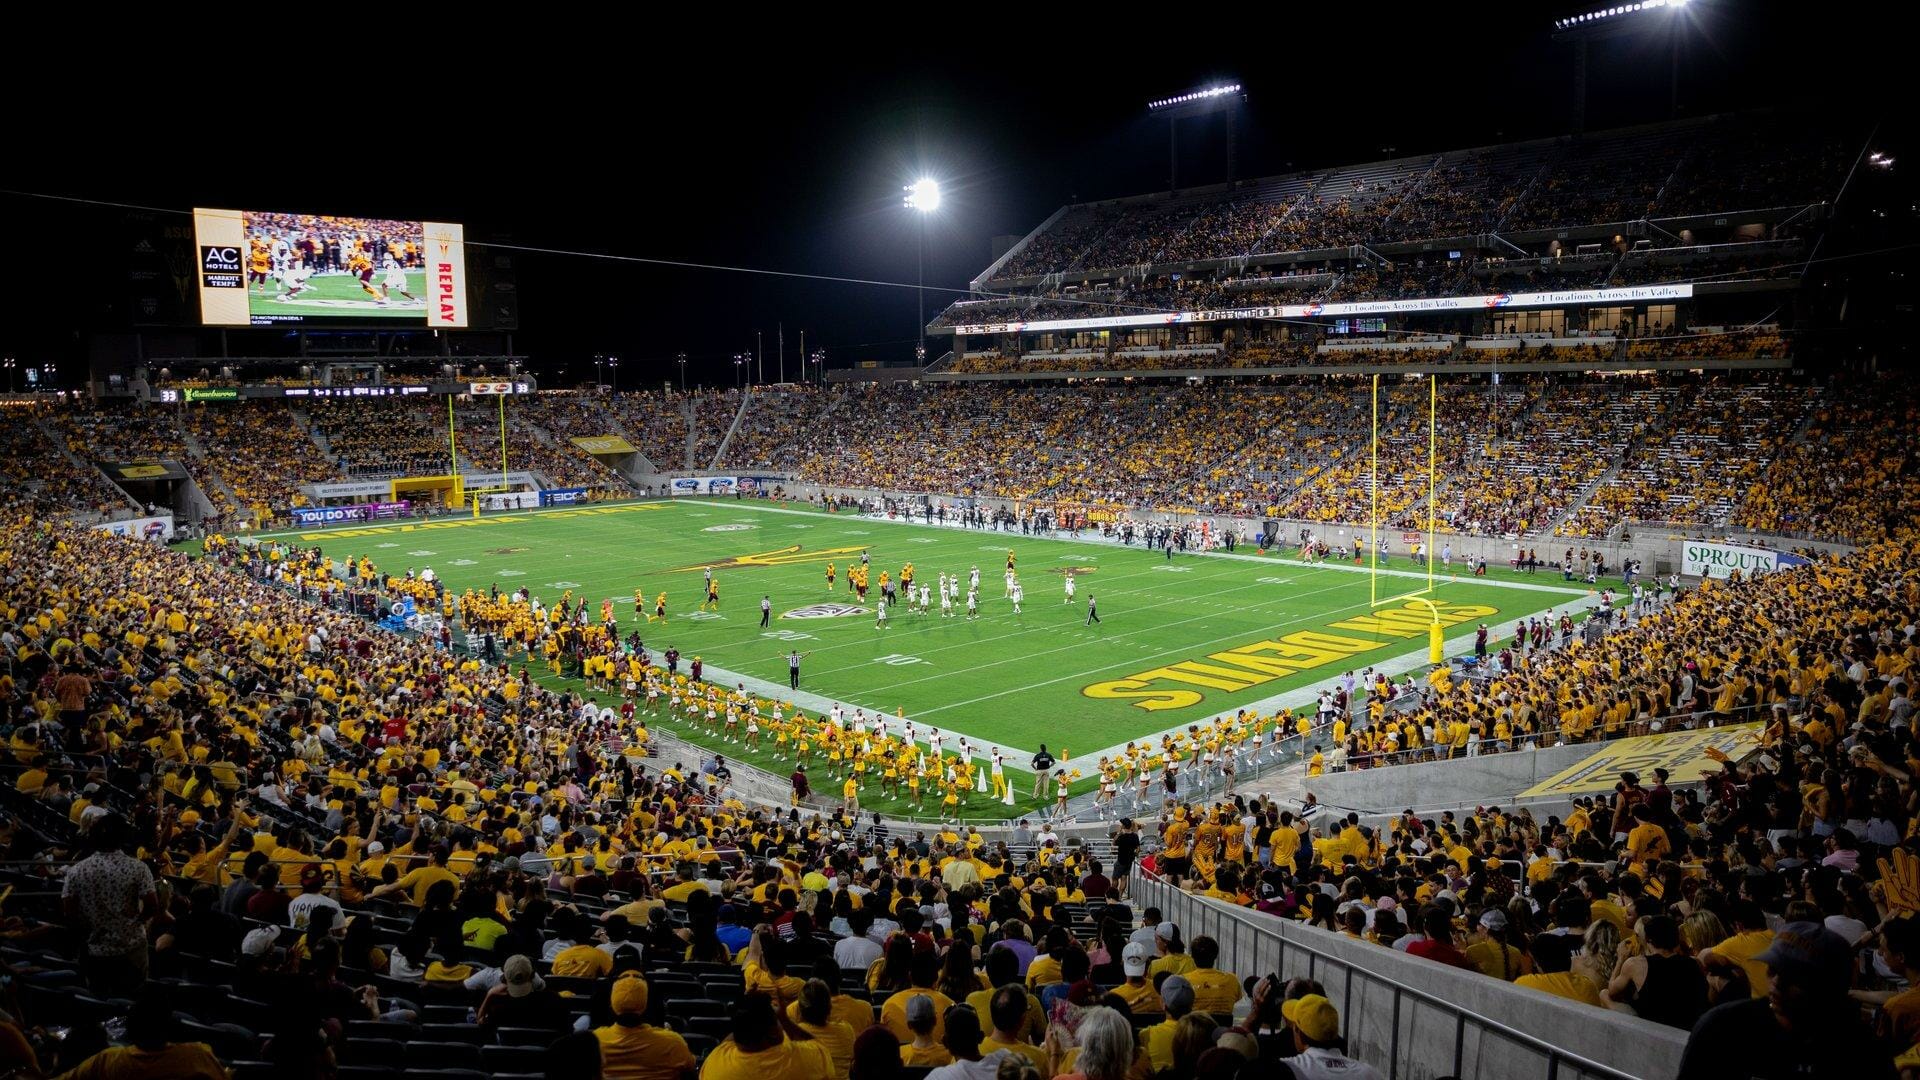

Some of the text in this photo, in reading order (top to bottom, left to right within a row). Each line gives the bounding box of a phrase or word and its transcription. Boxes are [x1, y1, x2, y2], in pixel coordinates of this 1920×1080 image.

[206, 247, 238, 263] AC
[438, 263, 456, 324] REPLAY
[1549, 292, 1593, 302] Locations
[1597, 290, 1628, 300] Across
[1631, 289, 1647, 298] the
[1650, 288, 1680, 298] Valley
[1354, 303, 1391, 312] Locations
[1394, 301, 1418, 311] Across
[1420, 300, 1433, 309] the
[1434, 299, 1459, 309] Valley
[162, 390, 177, 402] 33
[301, 511, 324, 522] YOU
[327, 510, 344, 520] DO
[1687, 546, 1771, 571] SPROUTS
[1691, 563, 1731, 577] FAMERS
[873, 653, 923, 666] 10
[1079, 599, 1501, 714] SUN DEVILS
